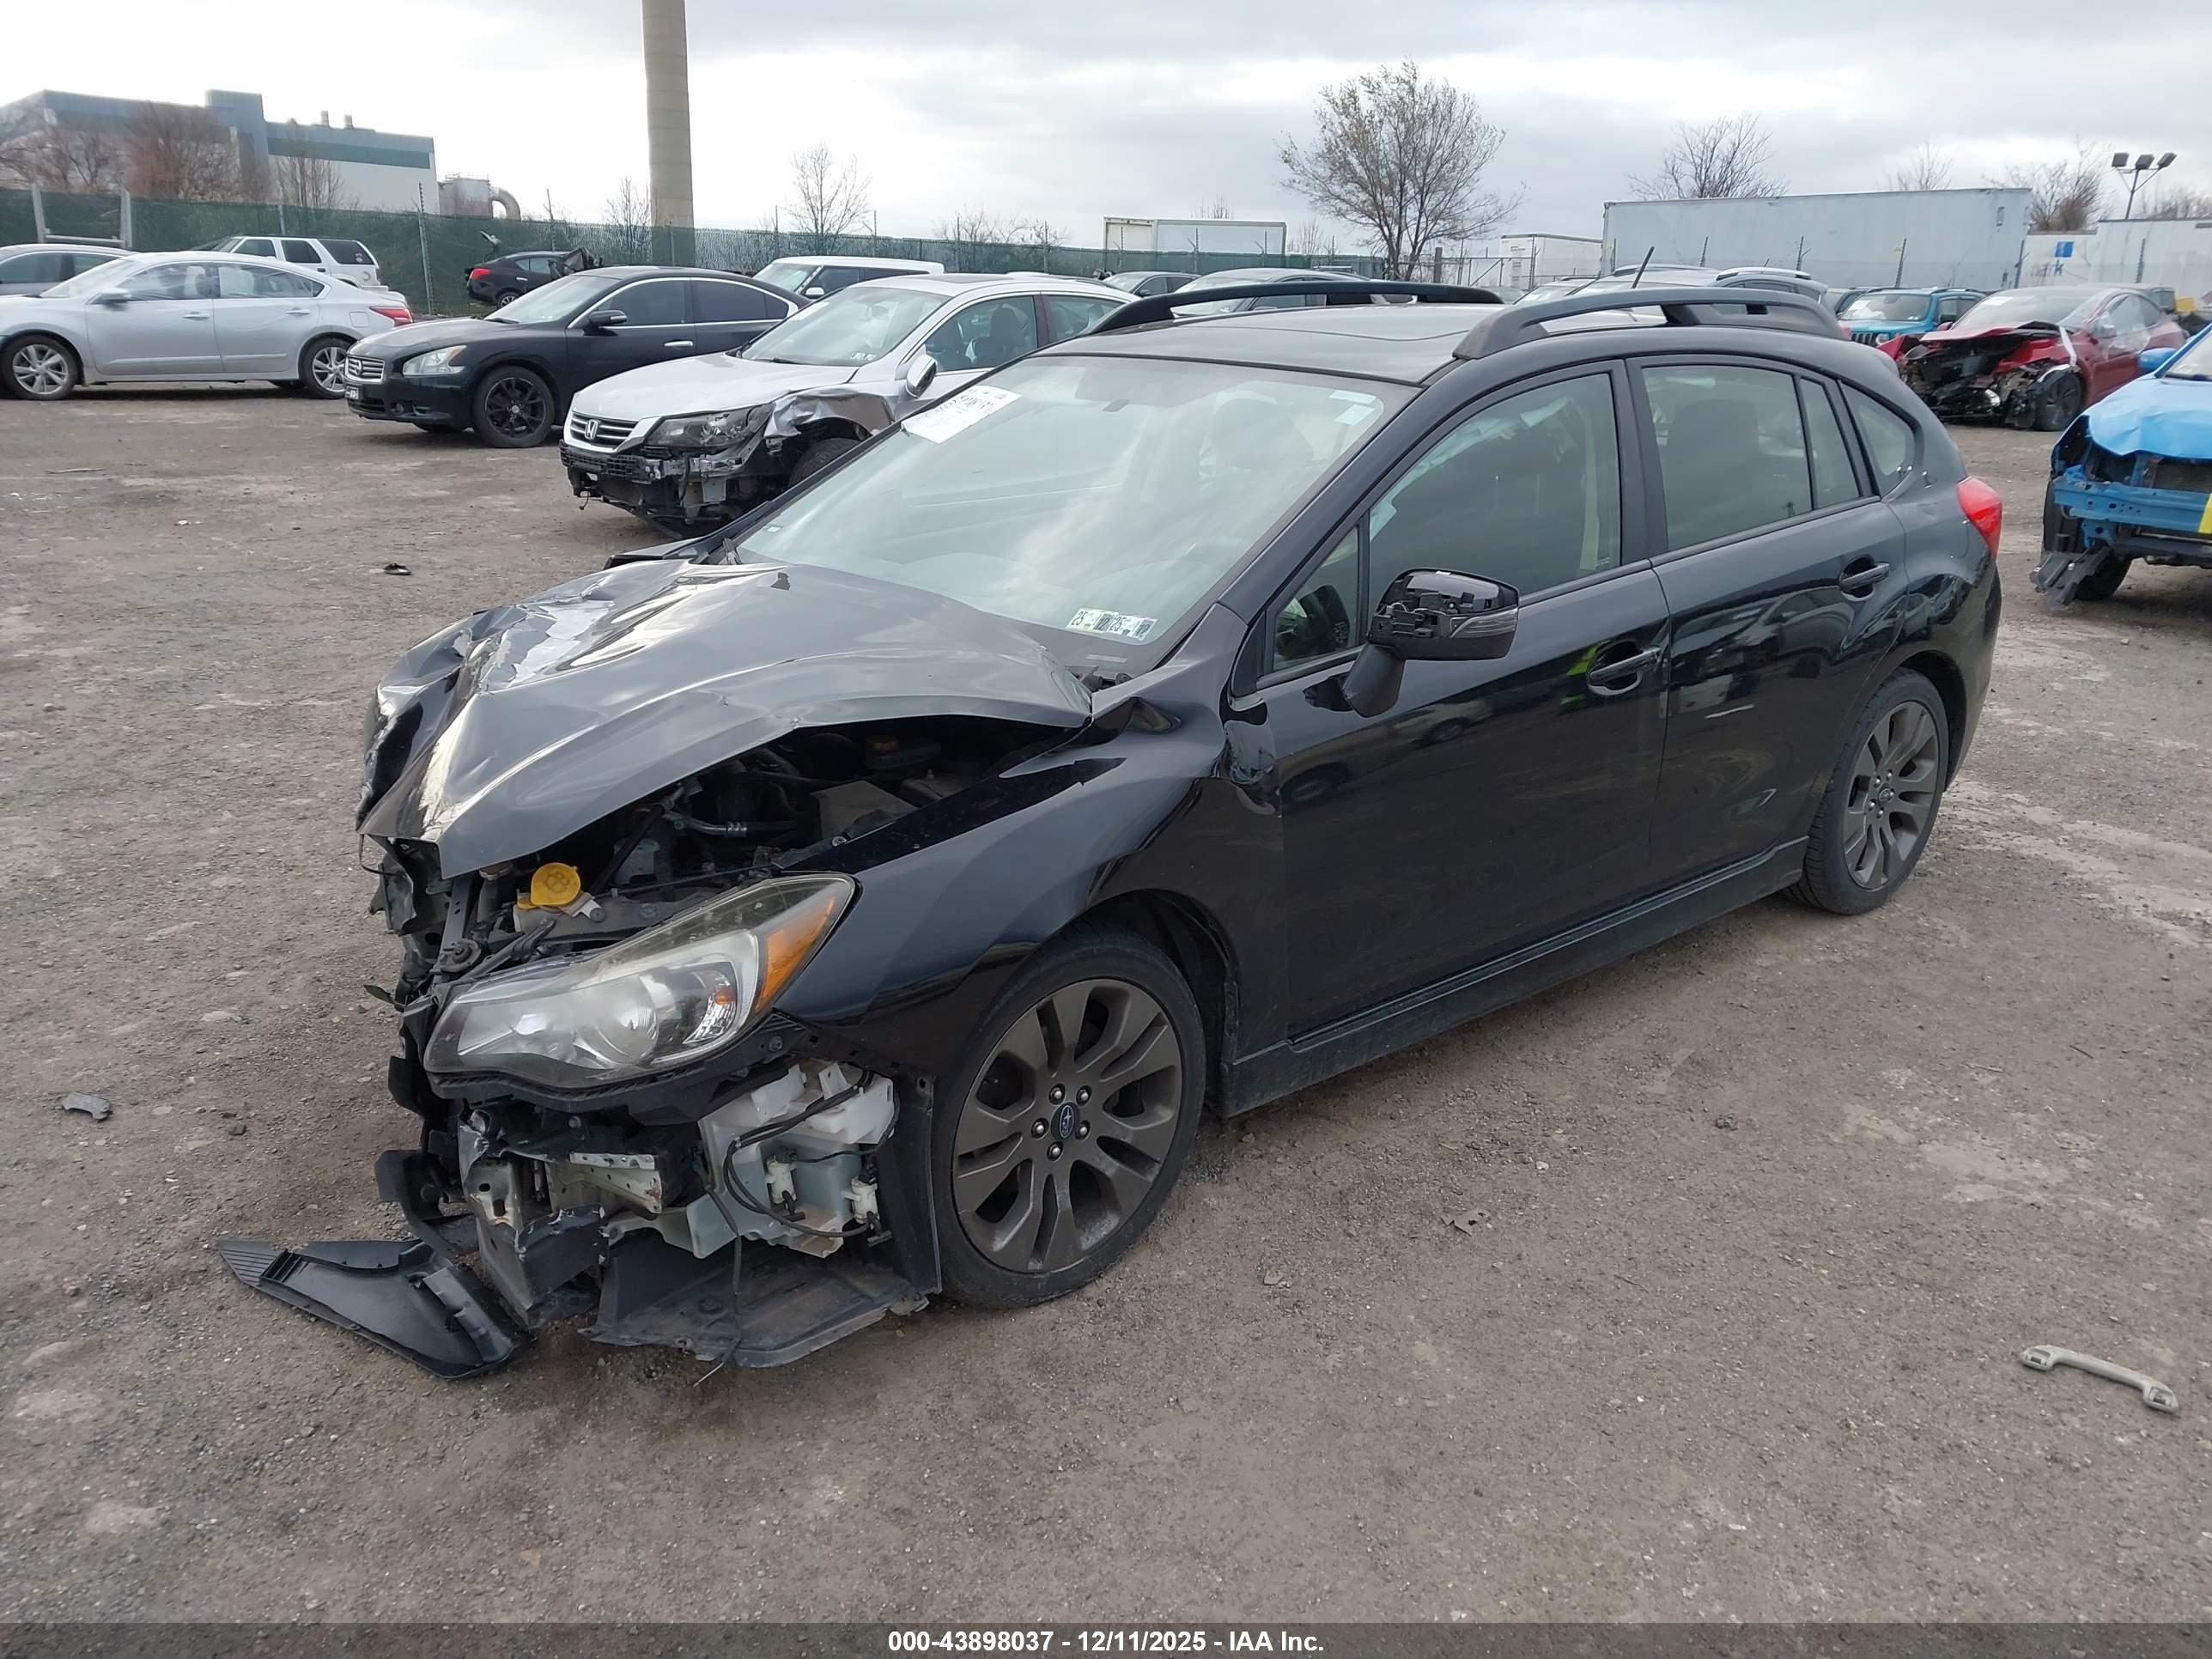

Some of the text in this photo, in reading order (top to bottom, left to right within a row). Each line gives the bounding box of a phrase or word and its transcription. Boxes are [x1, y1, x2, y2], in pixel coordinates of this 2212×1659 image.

[1071, 611, 1110, 631] 25 12
[1109, 616, 1127, 632] 25
